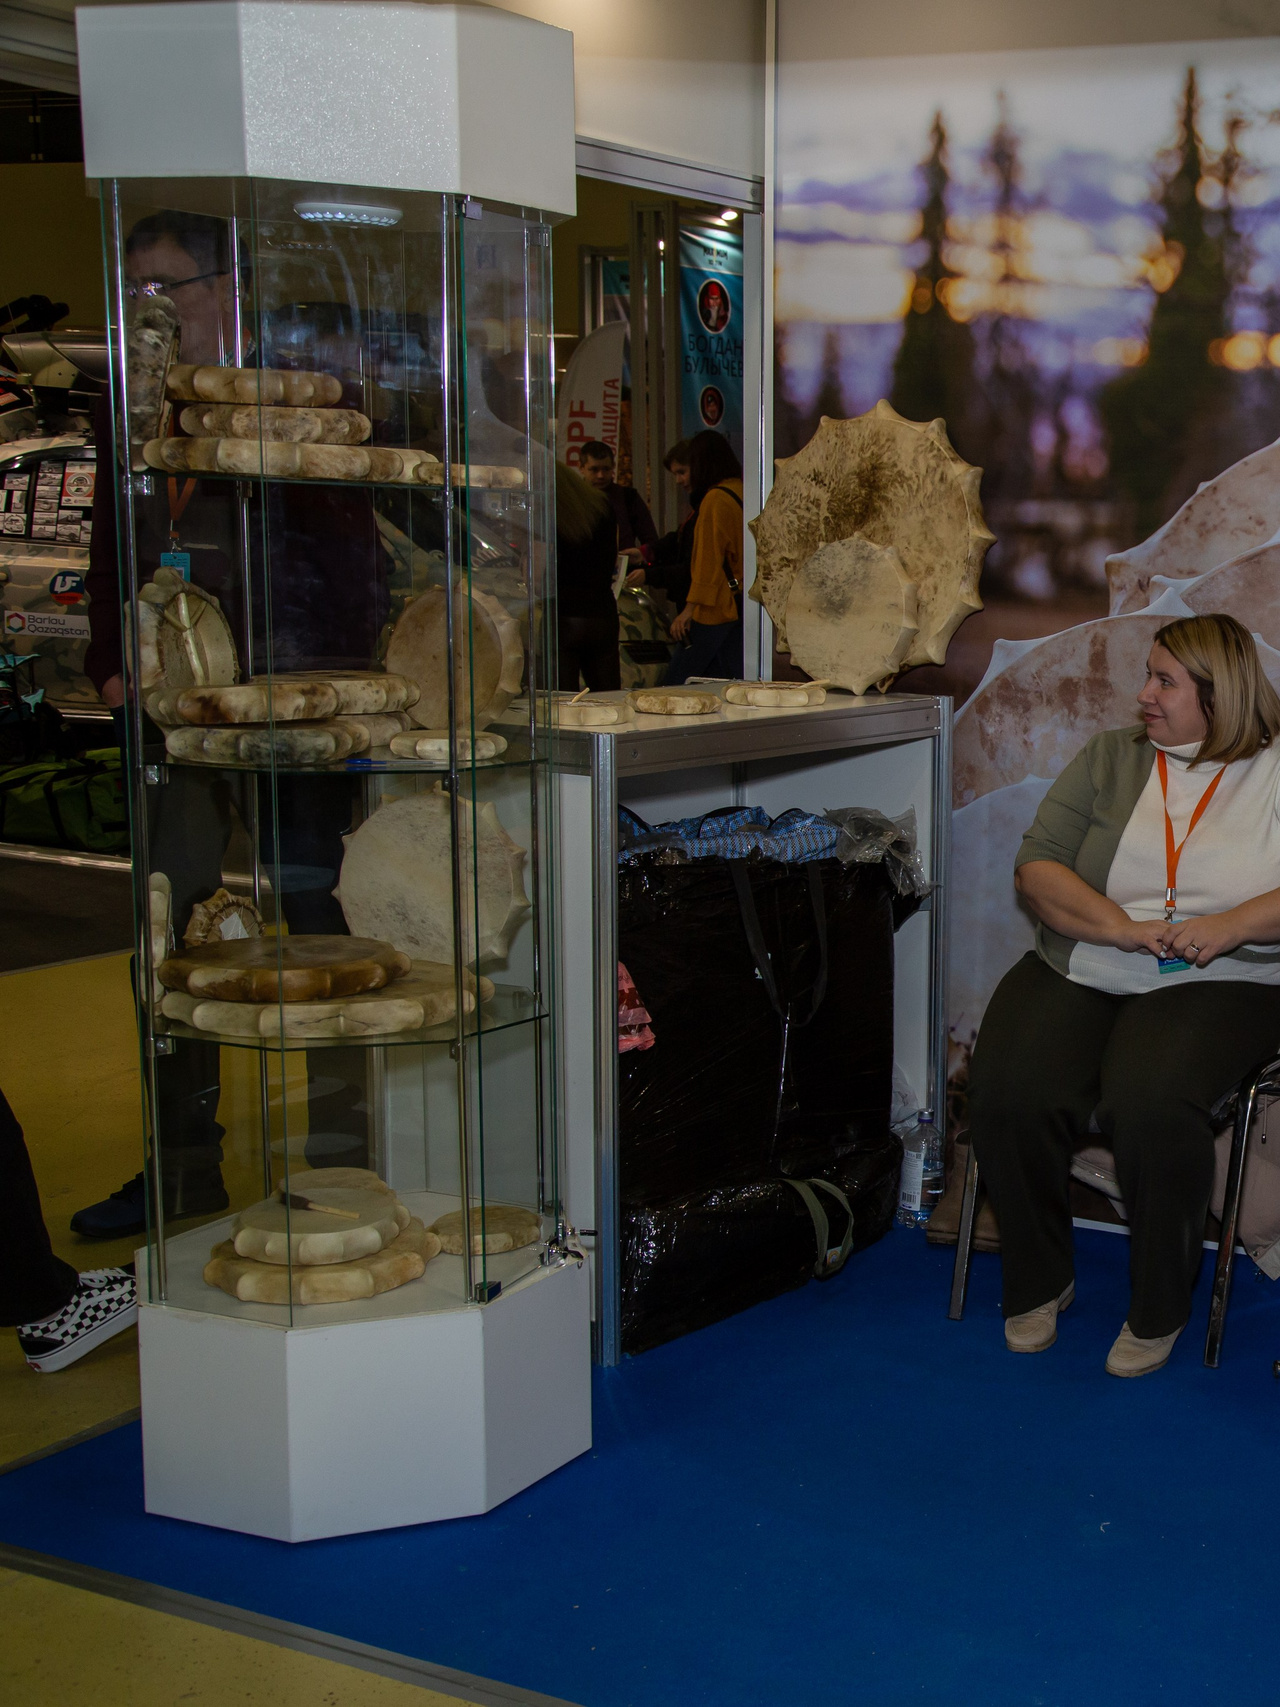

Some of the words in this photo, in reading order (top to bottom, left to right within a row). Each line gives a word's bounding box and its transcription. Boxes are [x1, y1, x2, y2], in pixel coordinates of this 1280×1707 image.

[688, 334, 743, 357] БОГДАН
[602, 378, 620, 457] АЩИТА
[28, 615, 66, 625] Barlau
[28, 624, 90, 636] Qazaqstan
